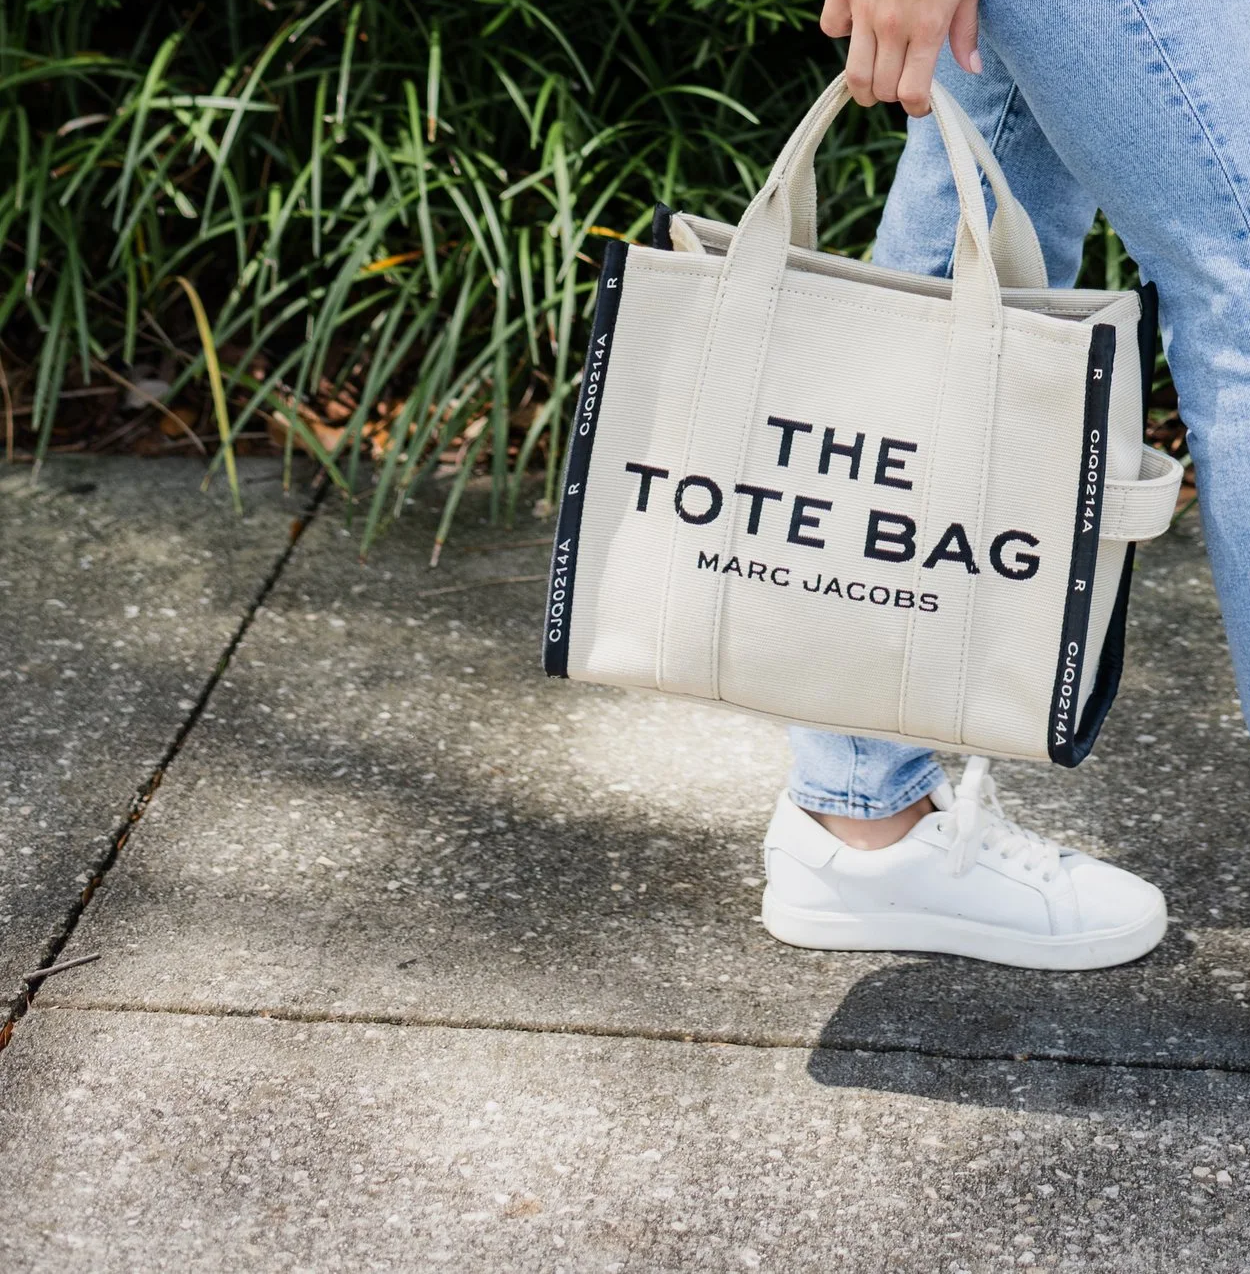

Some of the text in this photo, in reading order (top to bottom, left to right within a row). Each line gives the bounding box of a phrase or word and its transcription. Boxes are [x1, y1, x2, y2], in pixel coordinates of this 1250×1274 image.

[567, 482, 581, 496] R
[606, 277, 618, 289] R
[1092, 368, 1103, 380] R
[767, 415, 918, 491] THE
[625, 461, 1041, 581] TOTE BAG
[697, 550, 940, 613] MARC JACOBS
[1074, 578, 1087, 592] R
